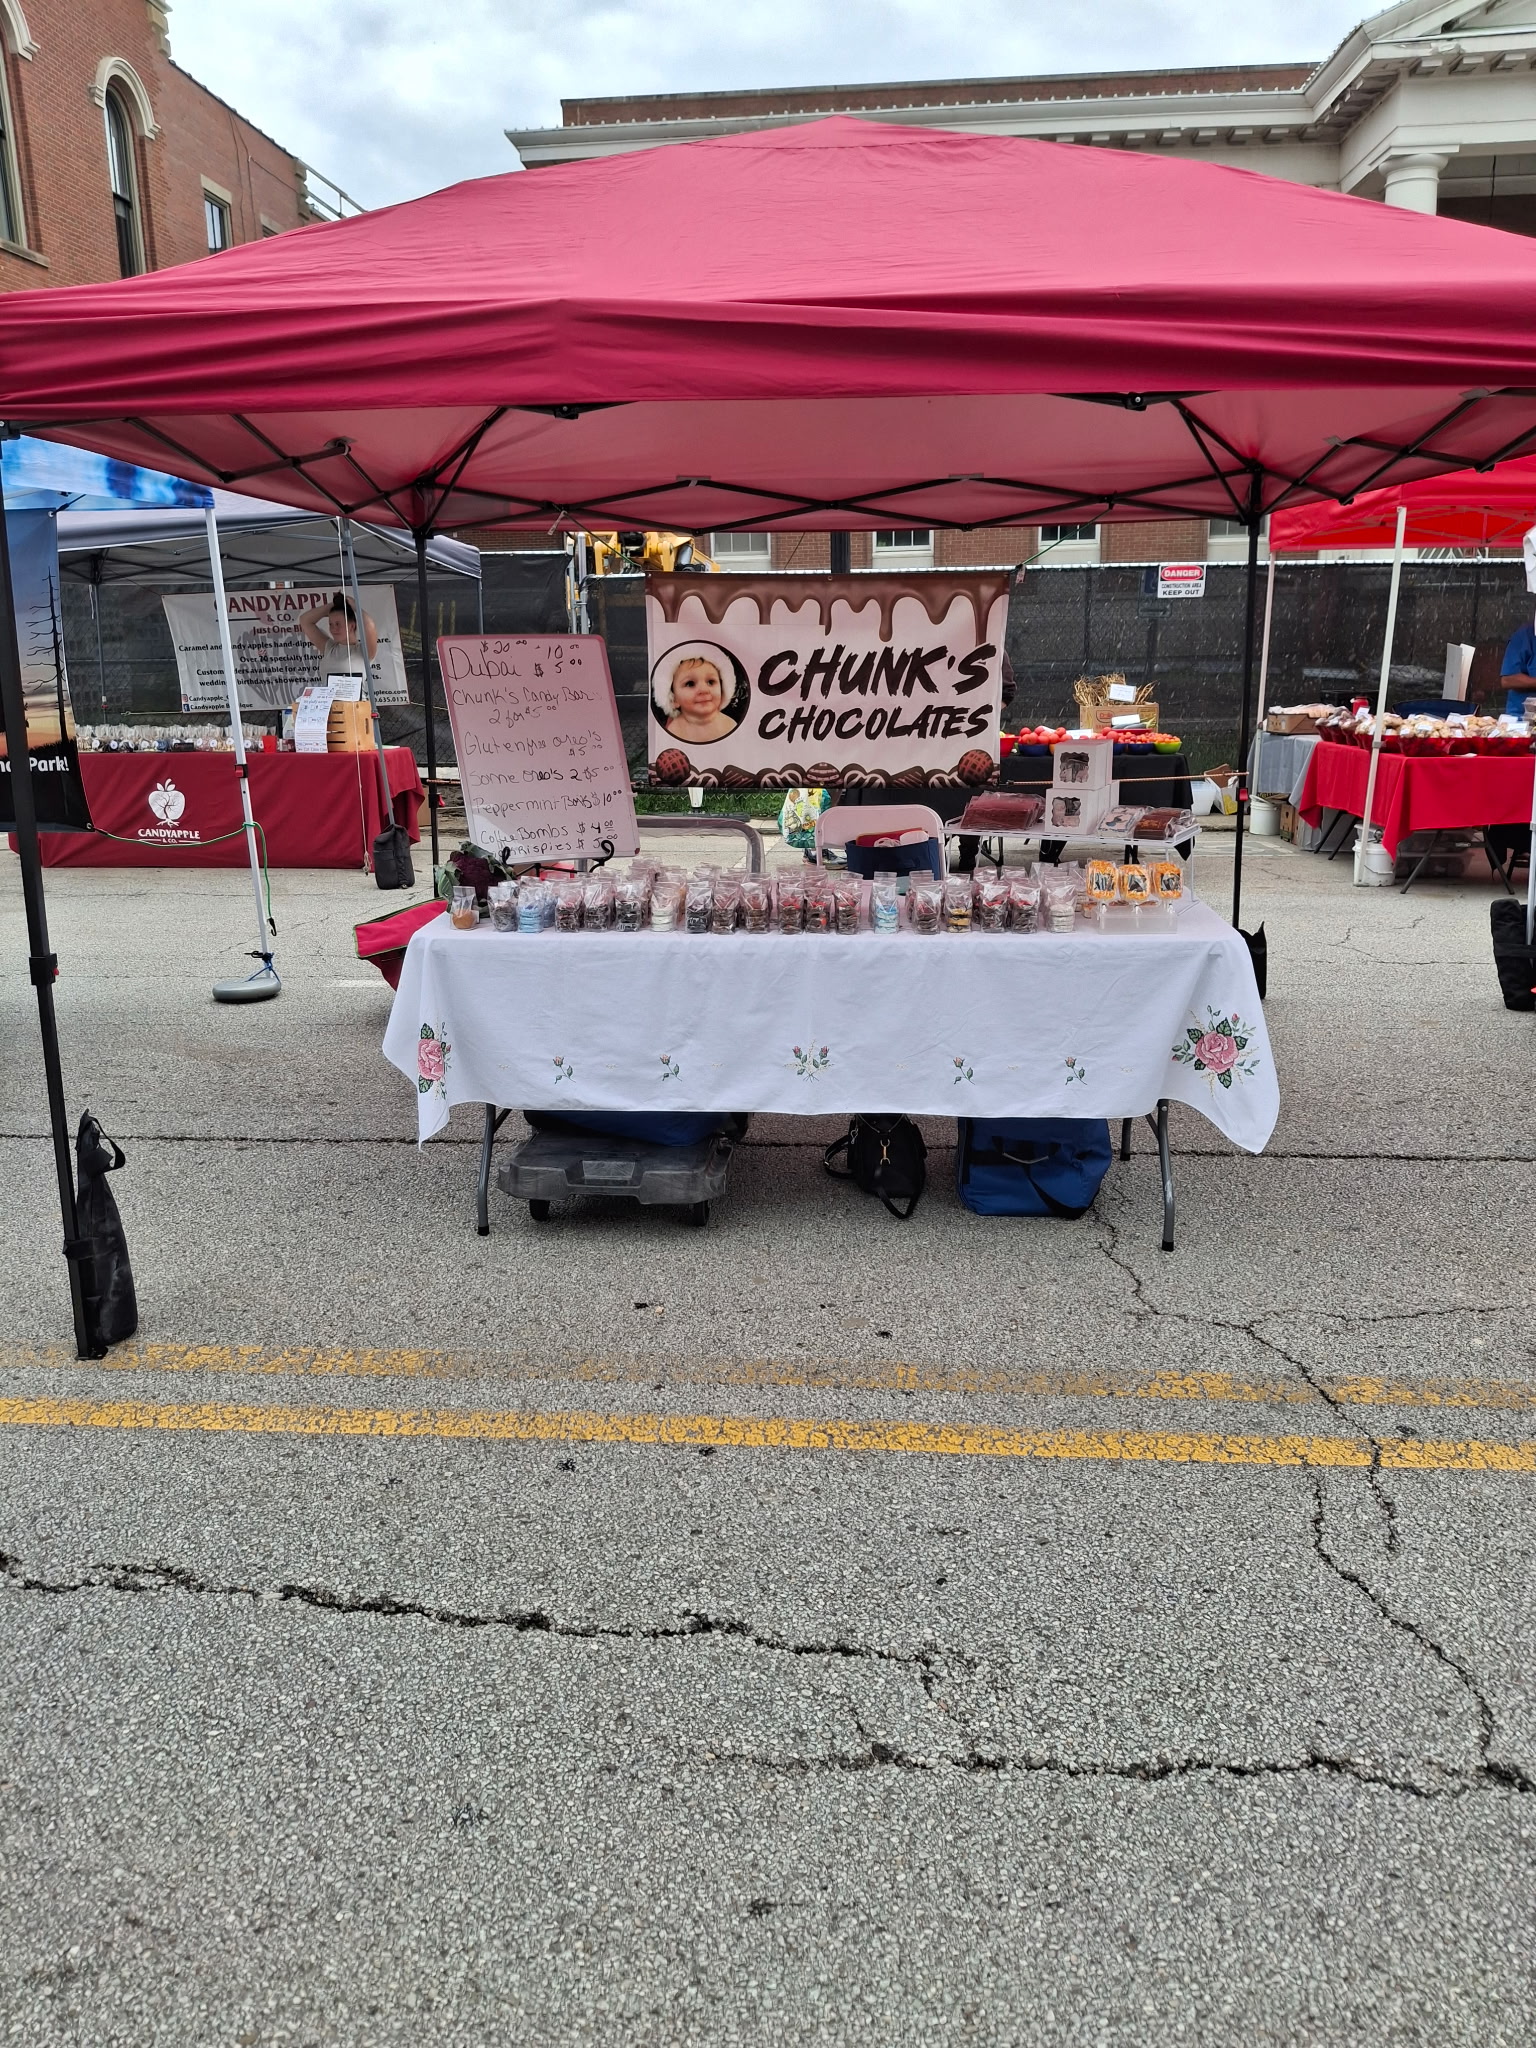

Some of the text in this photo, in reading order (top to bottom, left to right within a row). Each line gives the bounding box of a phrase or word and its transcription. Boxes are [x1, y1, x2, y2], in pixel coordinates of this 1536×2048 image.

[214, 592, 337, 613] ANDYAPPL
[267, 613, 294, 622] & CO.
[253, 626, 271, 636] Just
[272, 625, 292, 633] One
[179, 643, 209, 652] Caramel
[232, 642, 246, 650] ndy
[247, 641, 273, 650] apples
[270, 654, 304, 663] specialty
[448, 646, 522, 681] Dubai
[197, 668, 225, 676] Custom
[249, 665, 284, 674] available
[285, 664, 296, 672] for
[297, 664, 311, 674] any
[757, 643, 997, 702] CHUNK'S
[275, 675, 309, 685] showers,
[452, 686, 520, 706] Chunk's
[522, 686, 560, 705] Candy
[489, 708, 501, 725] 2
[506, 710, 525, 729] for
[757, 703, 994, 744] CHOCOLATES
[29, 755, 70, 772] Park!
[469, 770, 520, 787] Some
[570, 768, 583, 782] 2
[473, 796, 560, 818] Peppermint
[137, 828, 201, 840] CANDYAPPLE
[480, 829, 518, 849] Coffee
[516, 823, 569, 841] Bombs
